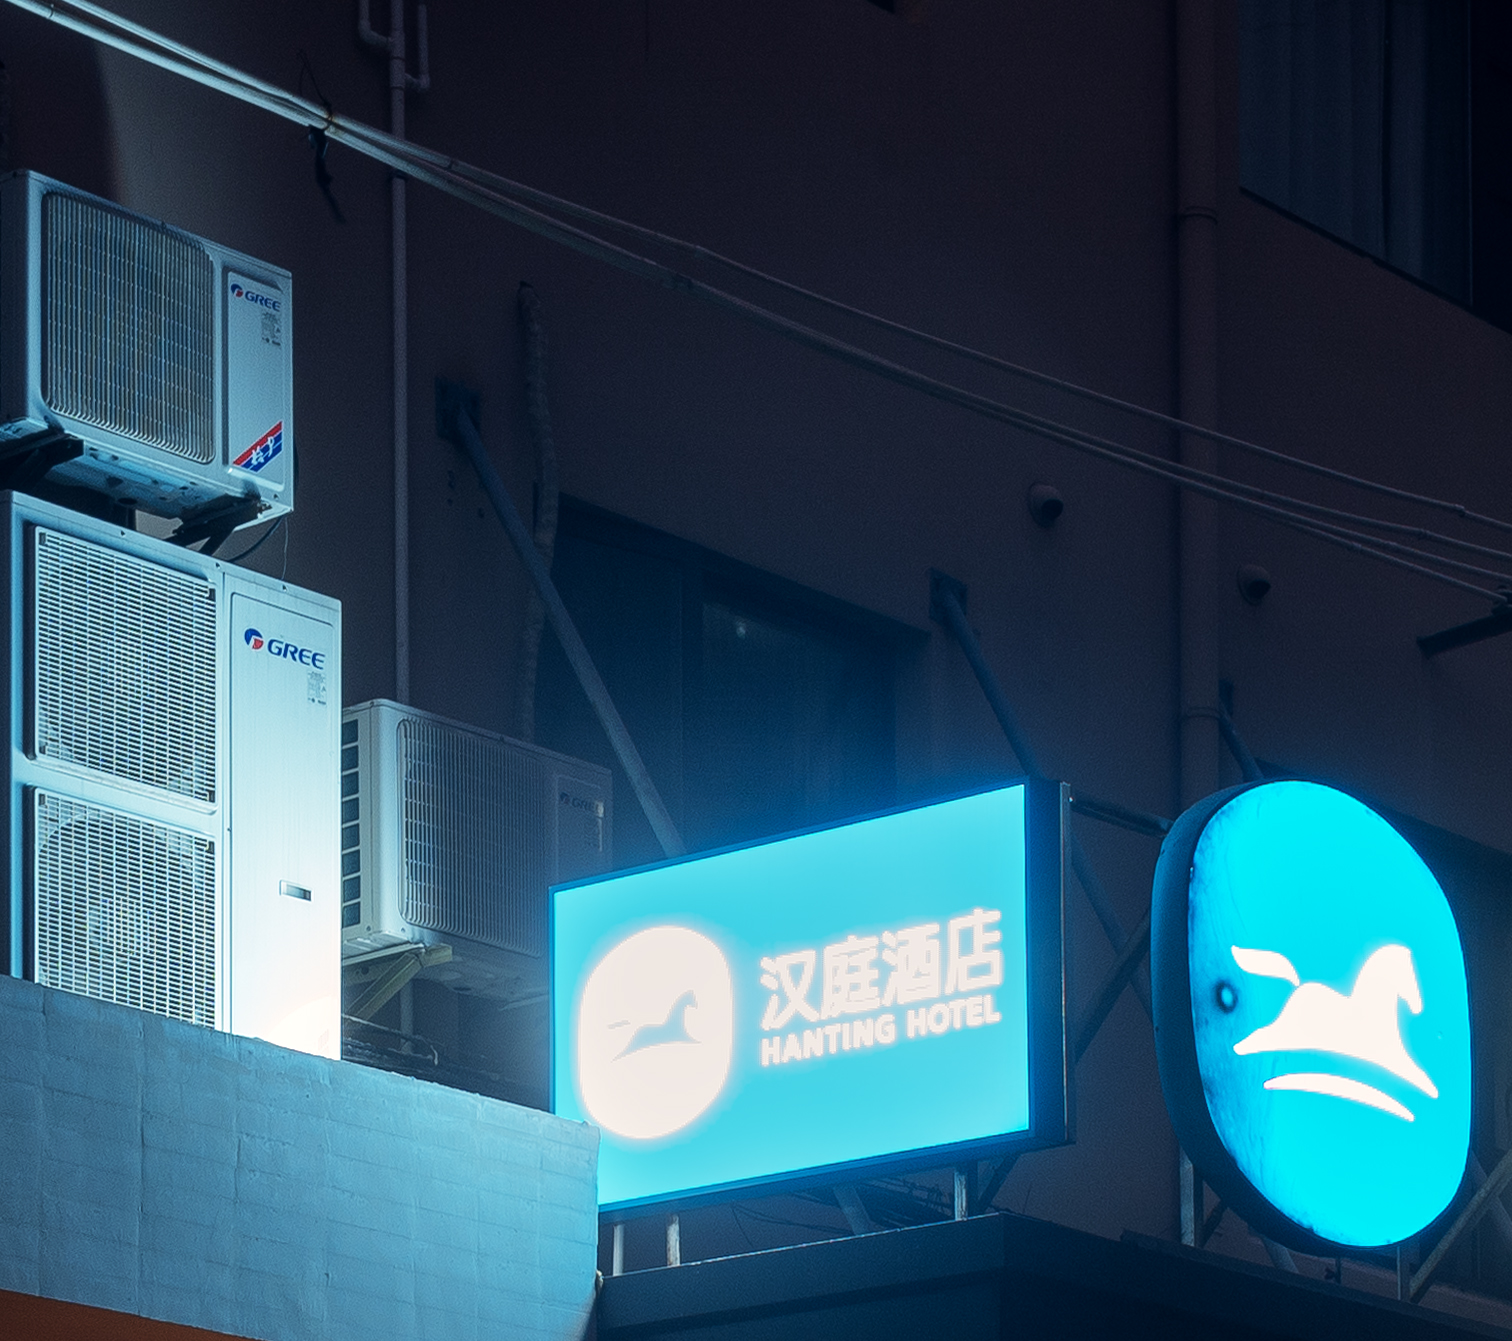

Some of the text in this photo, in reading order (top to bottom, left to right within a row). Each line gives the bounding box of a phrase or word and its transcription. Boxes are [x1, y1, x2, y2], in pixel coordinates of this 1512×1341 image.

[245, 291, 282, 312] GREE
[267, 638, 326, 670] GREE
[759, 906, 1003, 1031] 汉庭酒店
[759, 993, 1002, 1068] HANTING HOTEL
